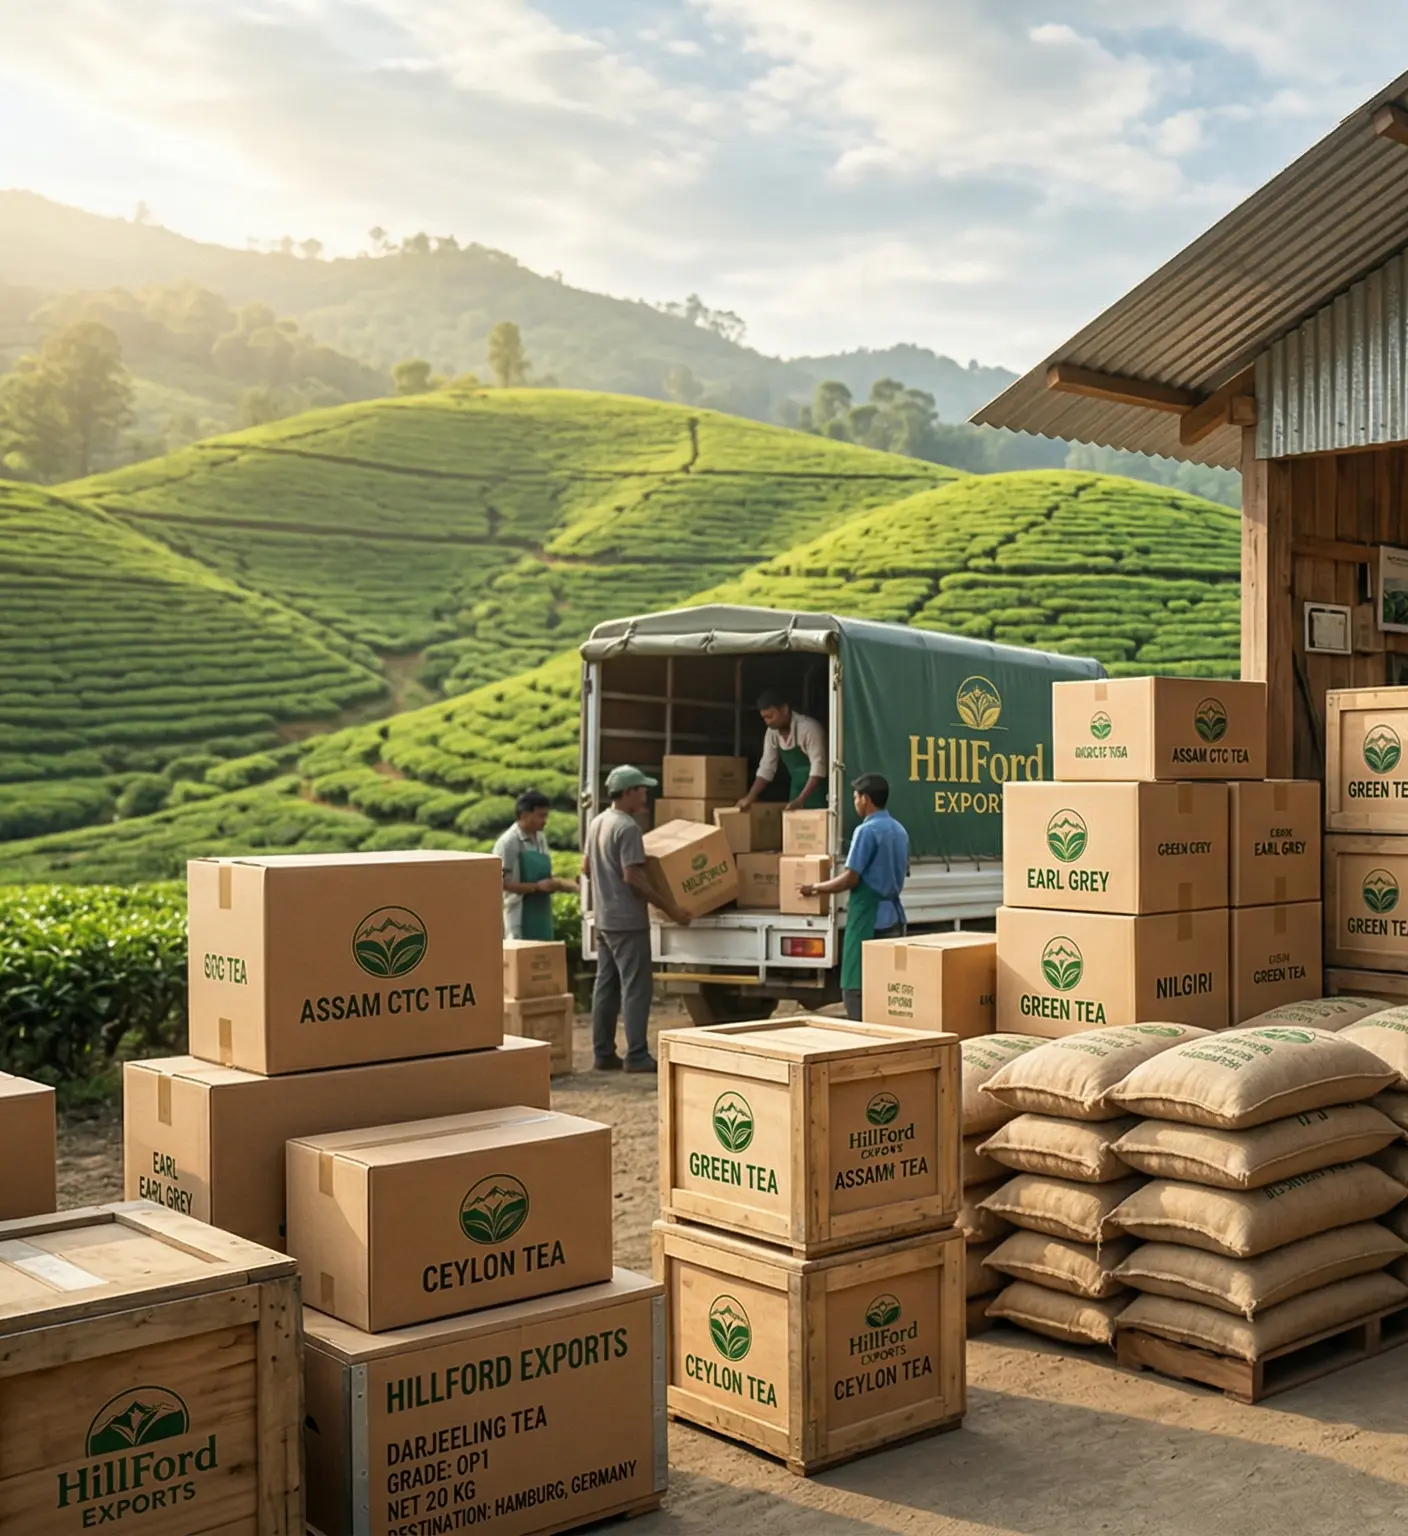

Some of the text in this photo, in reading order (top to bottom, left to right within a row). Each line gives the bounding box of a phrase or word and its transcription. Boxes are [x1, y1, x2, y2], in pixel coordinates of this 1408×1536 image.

[908, 734, 1044, 785] HillFord
[1172, 748, 1249, 764] ASSAM CTC TEA
[934, 791, 1004, 814] EXPOR
[1348, 781, 1389, 798] GREEN
[1027, 868, 1110, 892] EARL GREY
[1347, 917, 1388, 935] GREEN
[226, 957, 248, 985] TEA
[1156, 972, 1213, 999] NILGIRI
[1253, 964, 1306, 985] GREEN TEA
[300, 982, 477, 1024] ASSAM CTC TEA
[1020, 994, 1070, 1021] GREEN
[1074, 1000, 1107, 1025] TEA
[849, 1122, 915, 1149] HillFord
[153, 1151, 179, 1181] EARL
[689, 1151, 779, 1195] GREEN TEA
[900, 1156, 928, 1178] TEA
[166, 1185, 193, 1215] GREY
[423, 1240, 565, 1293] CEYLON TEA
[849, 1321, 918, 1356] HillFord
[861, 1344, 906, 1366] EXPORTS
[387, 1327, 628, 1414] HILLFORD EXPORTS
[685, 1353, 778, 1409] CEYLON TEA
[834, 1355, 933, 1400] CEYLON TEA
[387, 1405, 548, 1466] DARJEELING TEA
[56, 1434, 218, 1509] HillFord
[387, 1448, 490, 1495] GRADE: OP1
[495, 1480, 569, 1517] HAMBURG,
[571, 1459, 638, 1494] GERMANY
[82, 1481, 196, 1529] EXPORTS
[387, 1480, 476, 1523] NET 20 KG
